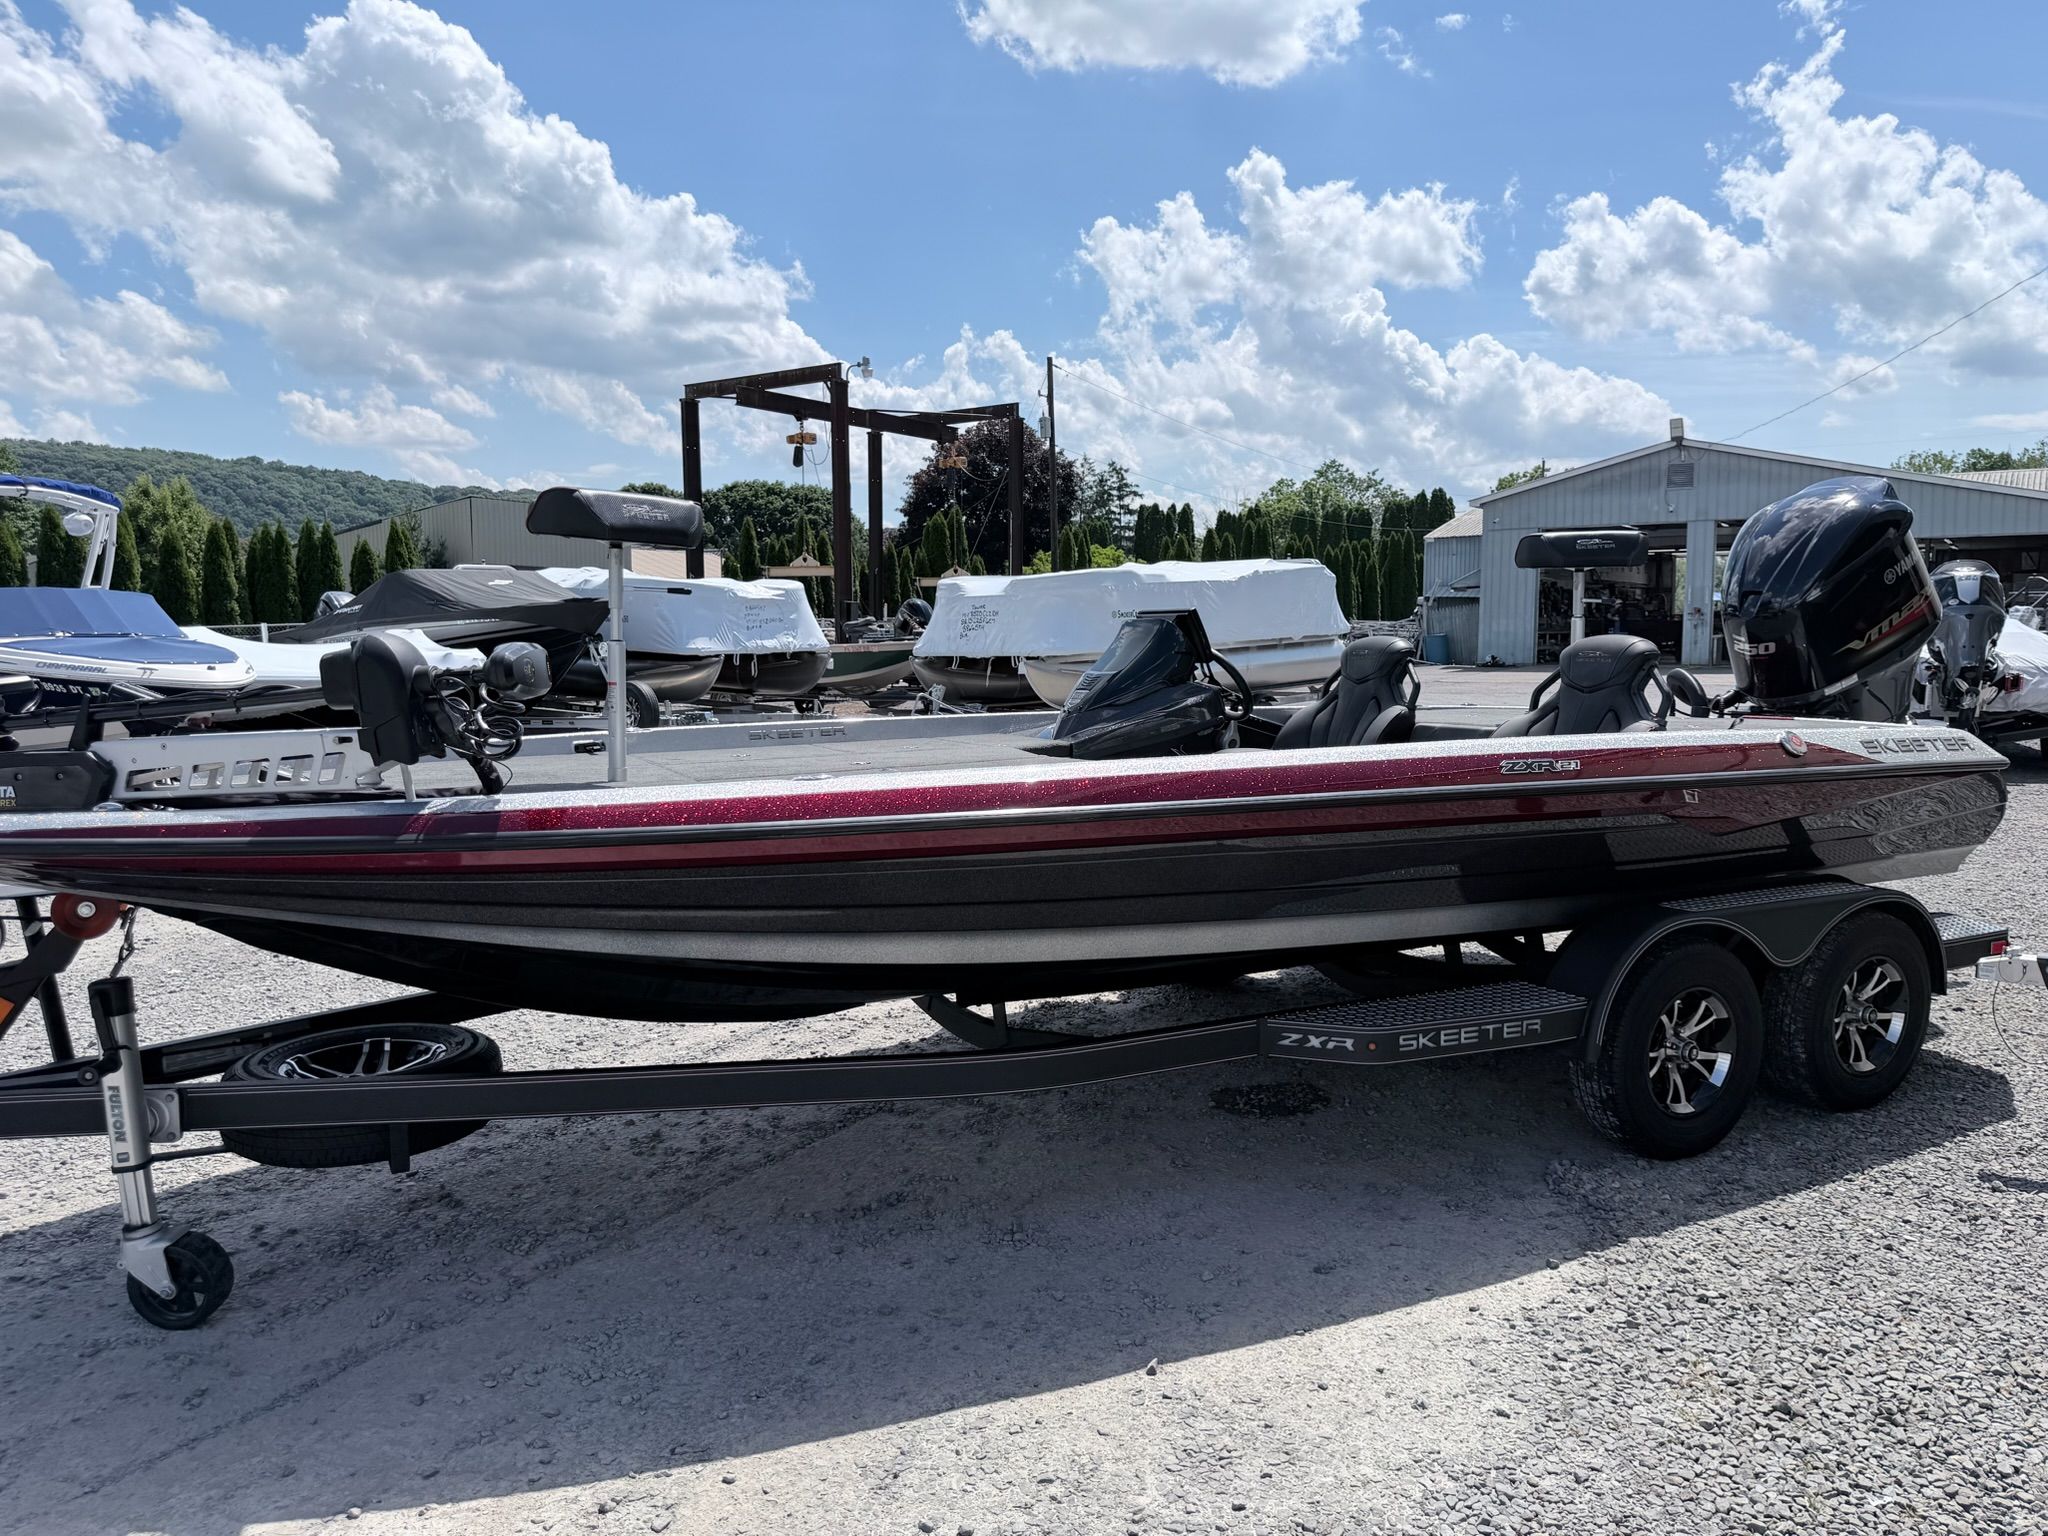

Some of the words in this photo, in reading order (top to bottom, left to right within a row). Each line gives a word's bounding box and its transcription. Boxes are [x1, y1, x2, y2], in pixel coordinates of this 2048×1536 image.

[1733, 640, 1776, 656] 250
[35, 661, 109, 674] CHAPARRAL
[69, 684, 85, 695] DT
[748, 725, 847, 740] SKEETER
[1860, 736, 1976, 754] SKEETER
[1276, 1032, 1355, 1051] ZXR
[1399, 1019, 1542, 1051] SKEETER
[107, 1085, 128, 1143] FULTON
